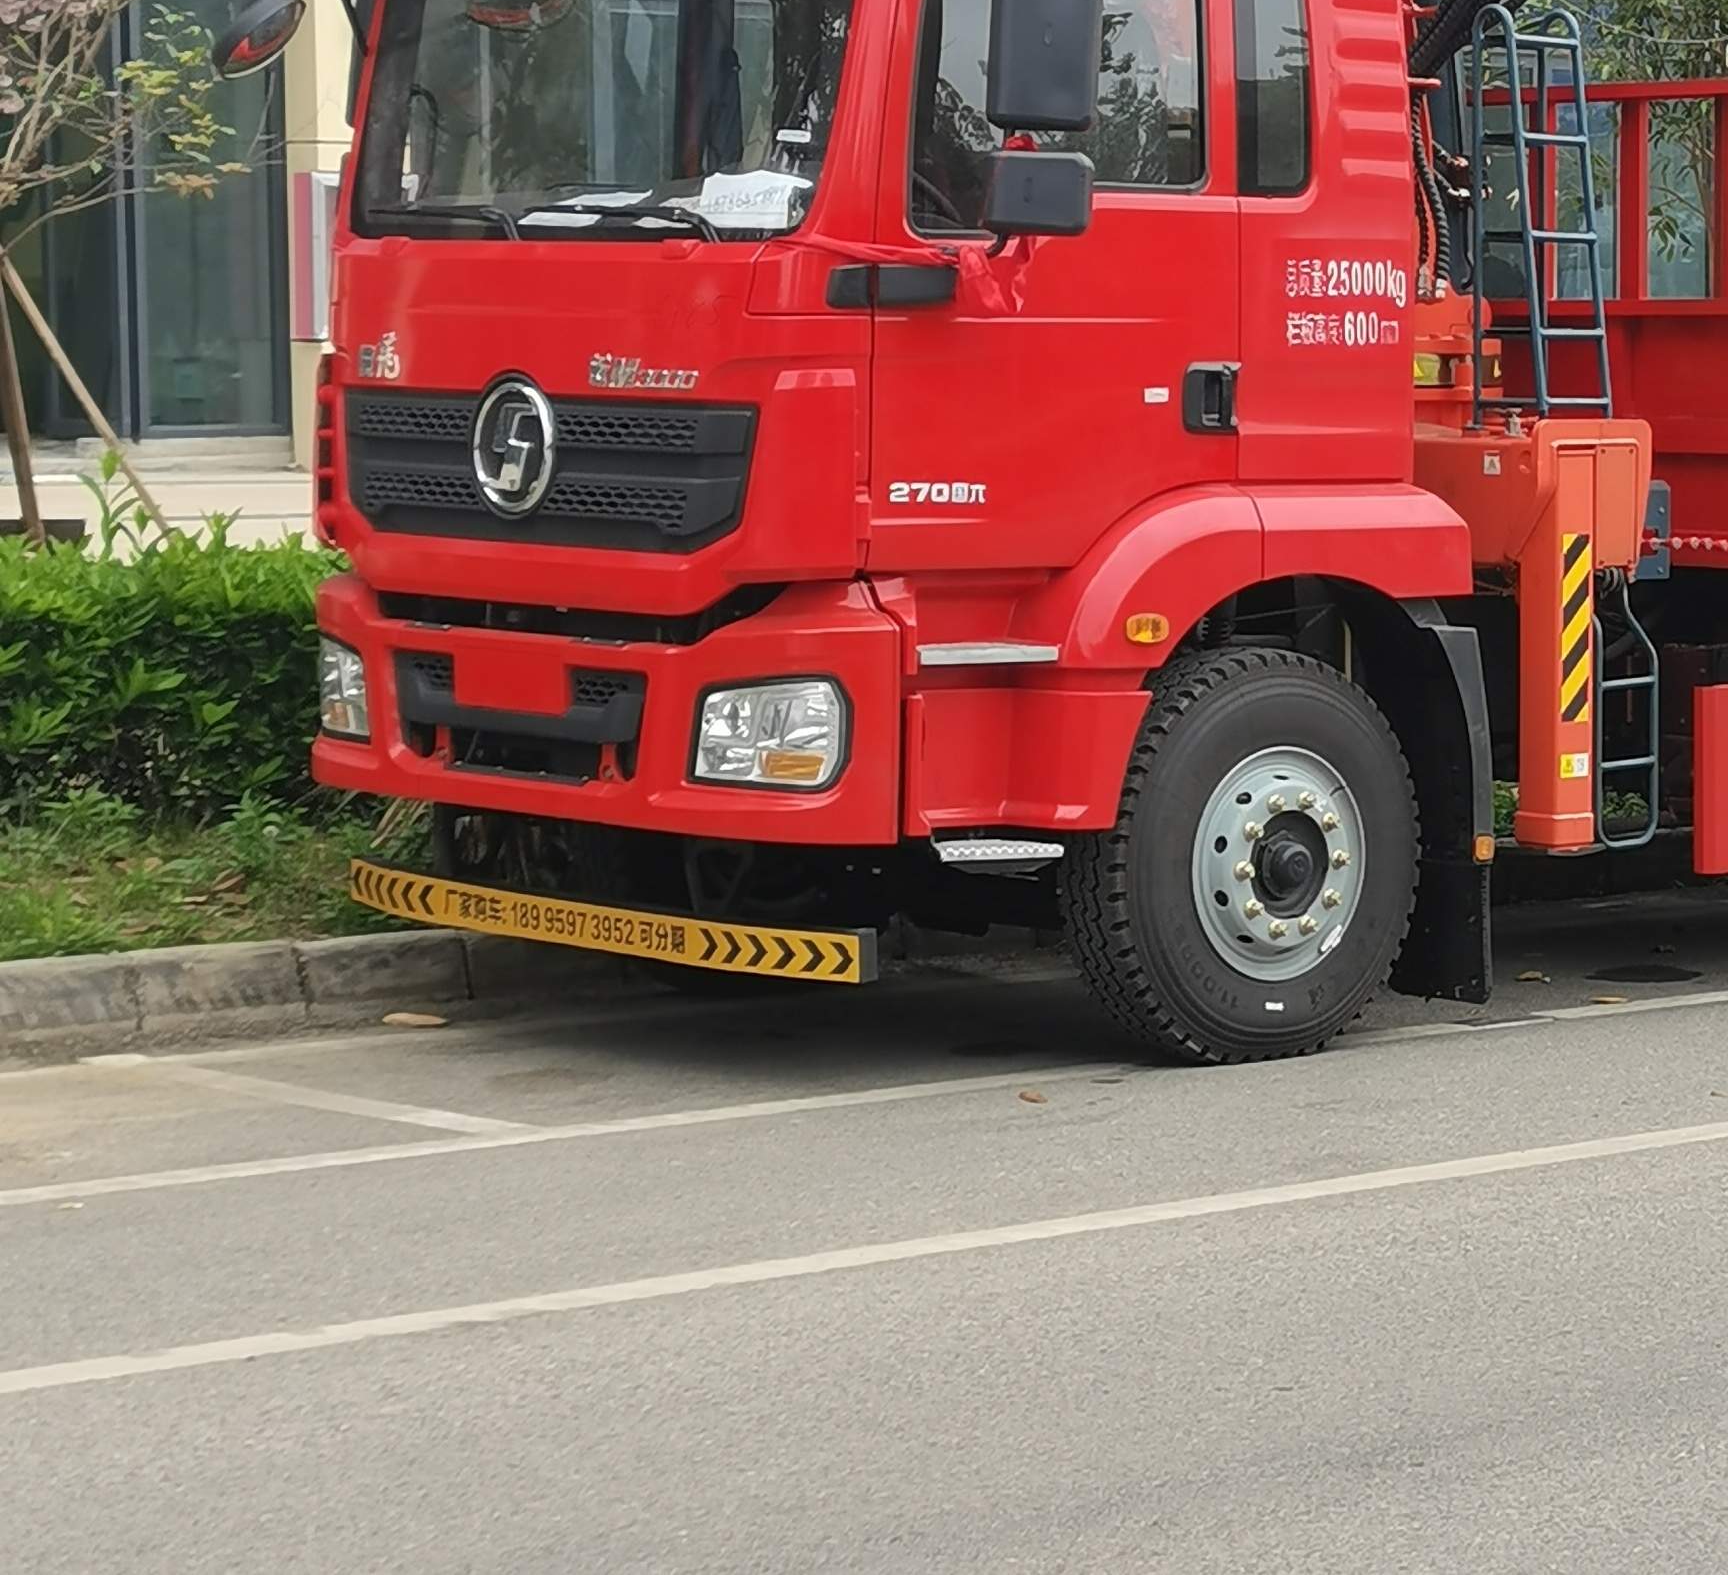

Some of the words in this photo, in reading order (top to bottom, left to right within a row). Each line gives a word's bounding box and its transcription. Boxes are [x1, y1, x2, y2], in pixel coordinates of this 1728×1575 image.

[511, 900, 541, 931] 189
[543, 906, 588, 939] 9597
[590, 913, 635, 945] 3952
